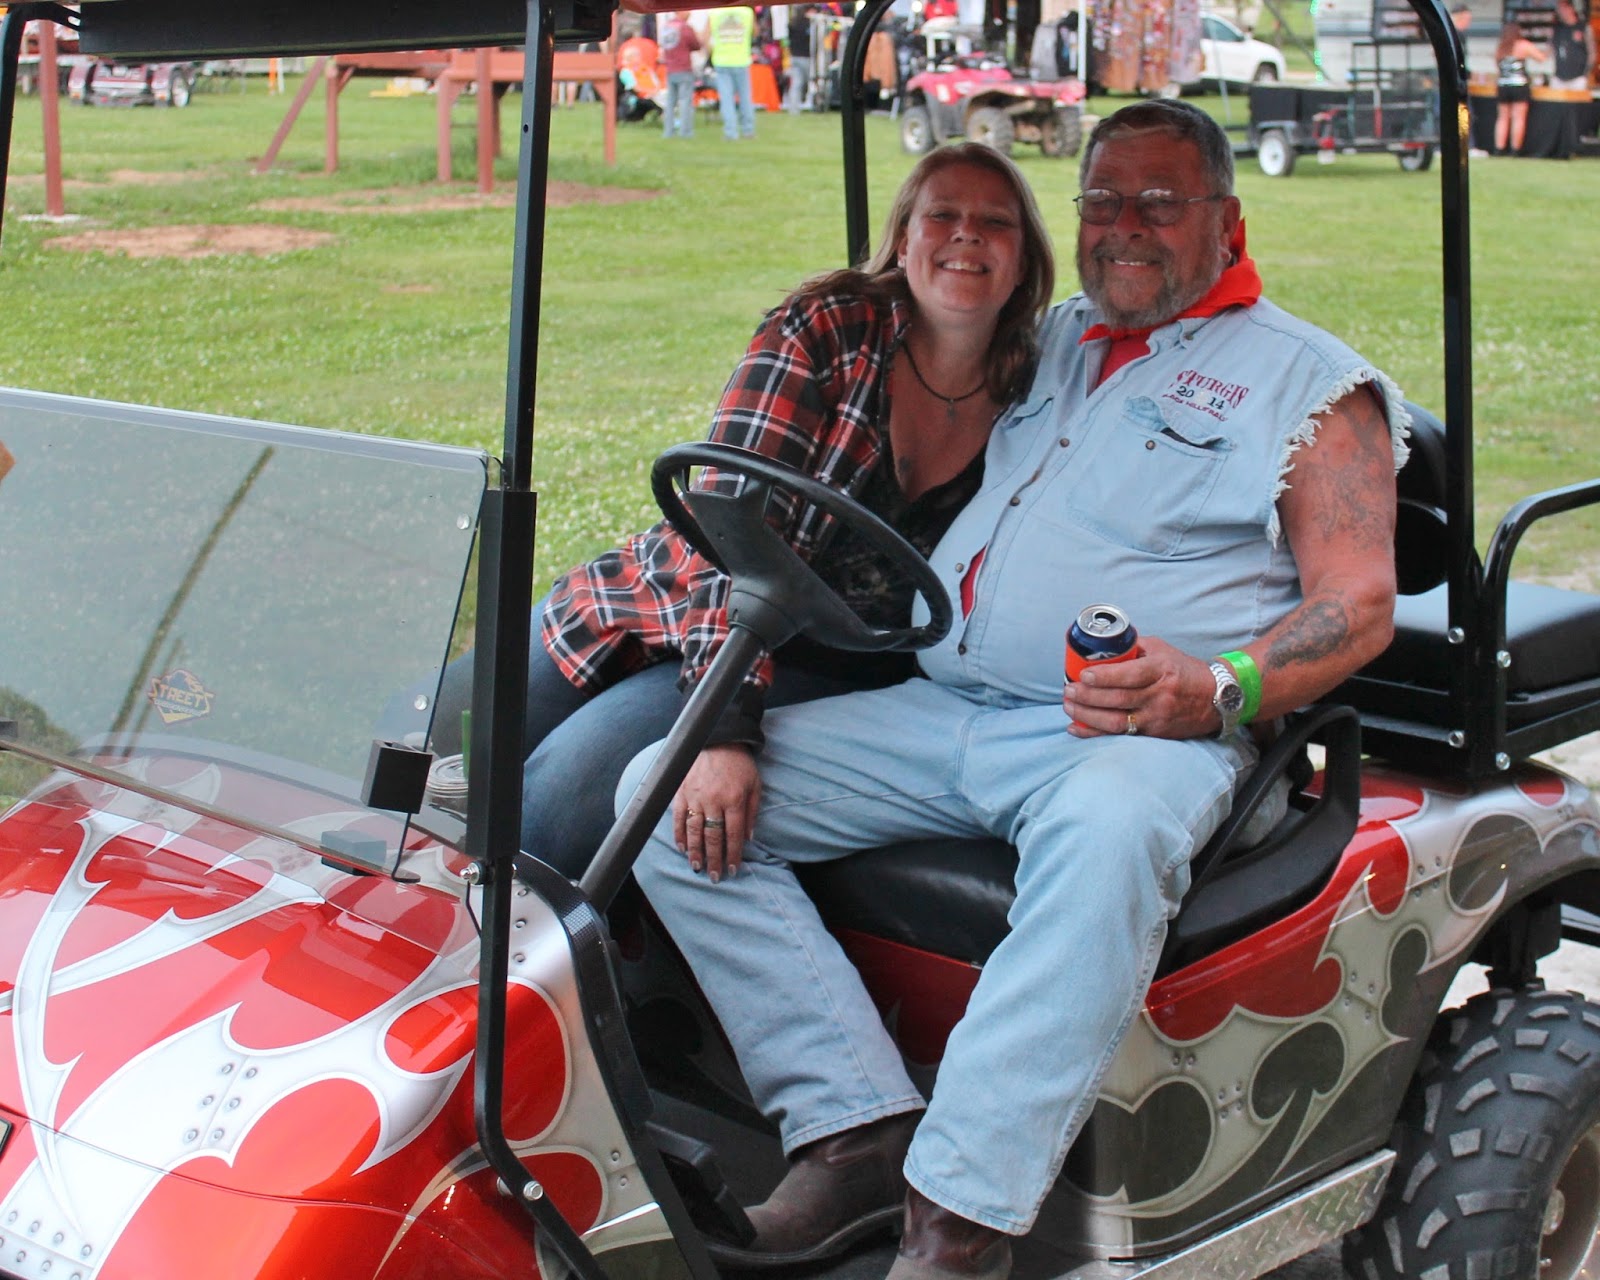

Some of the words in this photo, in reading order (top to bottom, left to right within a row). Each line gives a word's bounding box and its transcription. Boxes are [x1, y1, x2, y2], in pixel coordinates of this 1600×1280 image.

[1170, 370, 1249, 409] STURGIS
[1176, 385, 1195, 398] 20
[1207, 397, 1225, 410] 14
